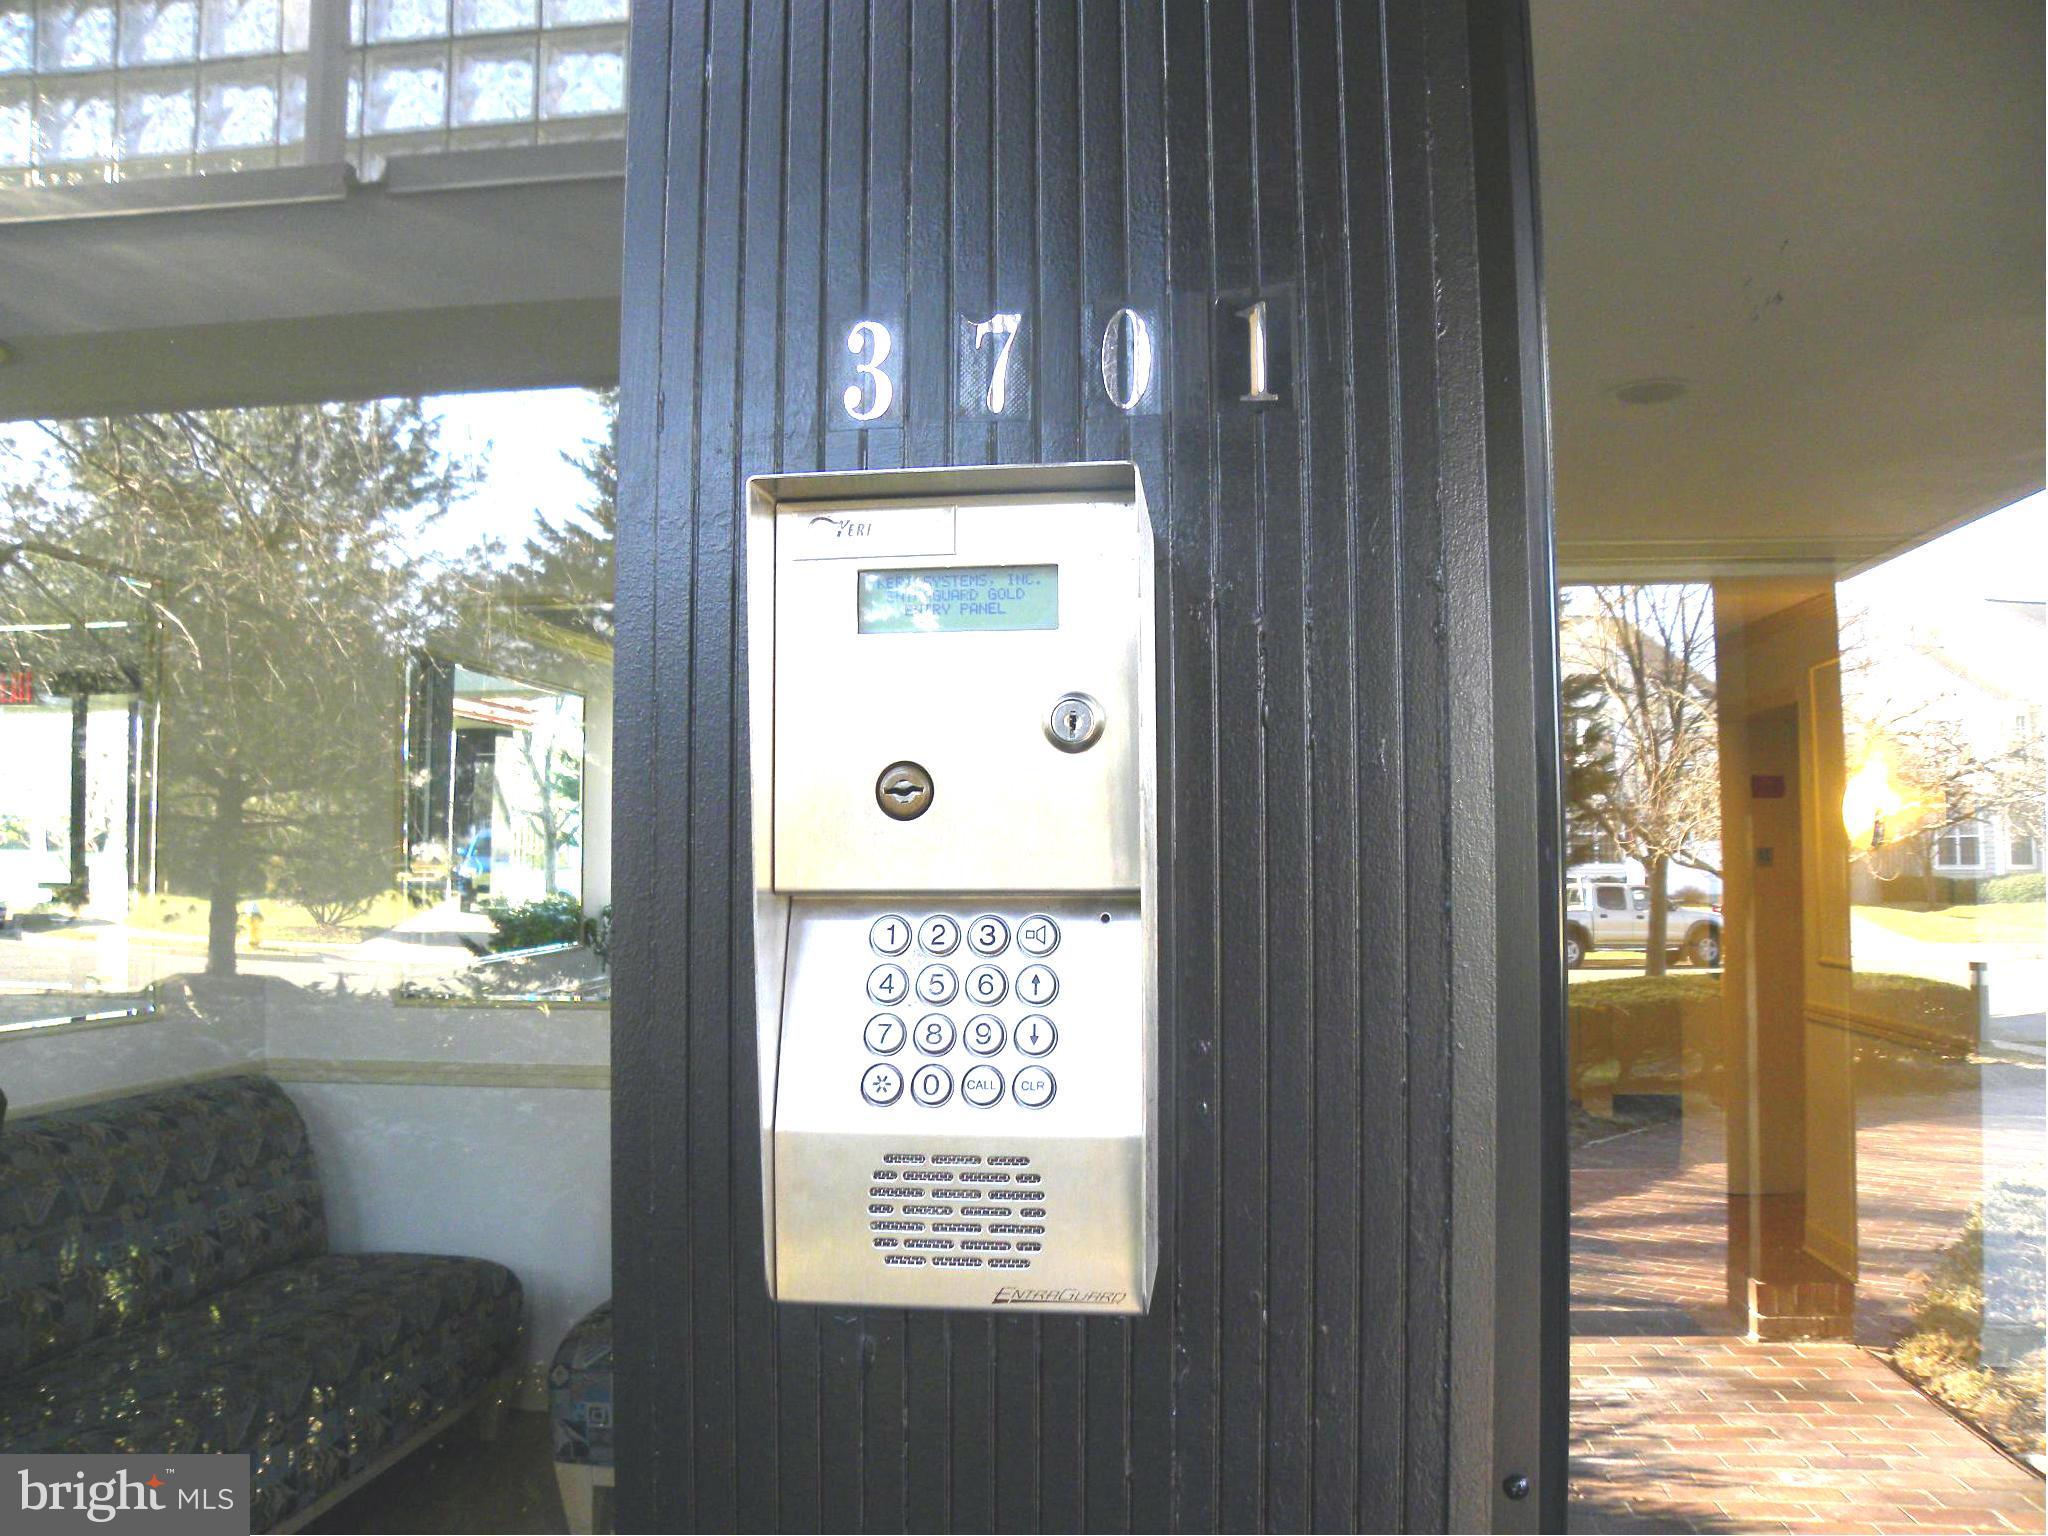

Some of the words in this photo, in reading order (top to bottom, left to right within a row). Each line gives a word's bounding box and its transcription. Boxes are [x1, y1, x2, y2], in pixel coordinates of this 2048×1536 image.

[843, 301, 1279, 421] 3701
[1007, 573, 1041, 586] INC.
[886, 589, 979, 602] ENGUARD
[988, 588, 1025, 600] GOLD
[960, 602, 1007, 615] PANEL
[887, 924, 896, 945] 1
[931, 924, 945, 945] 2
[979, 924, 996, 946] 3
[879, 973, 895, 994] 4
[928, 974, 945, 996] 5
[978, 973, 994, 995] 6
[878, 1023, 893, 1044] 7
[925, 1023, 943, 1045] 8
[975, 1022, 992, 1045] 9
[923, 1073, 940, 1096] 0
[967, 1079, 996, 1091] CALL
[1021, 1080, 1044, 1092] CLR
